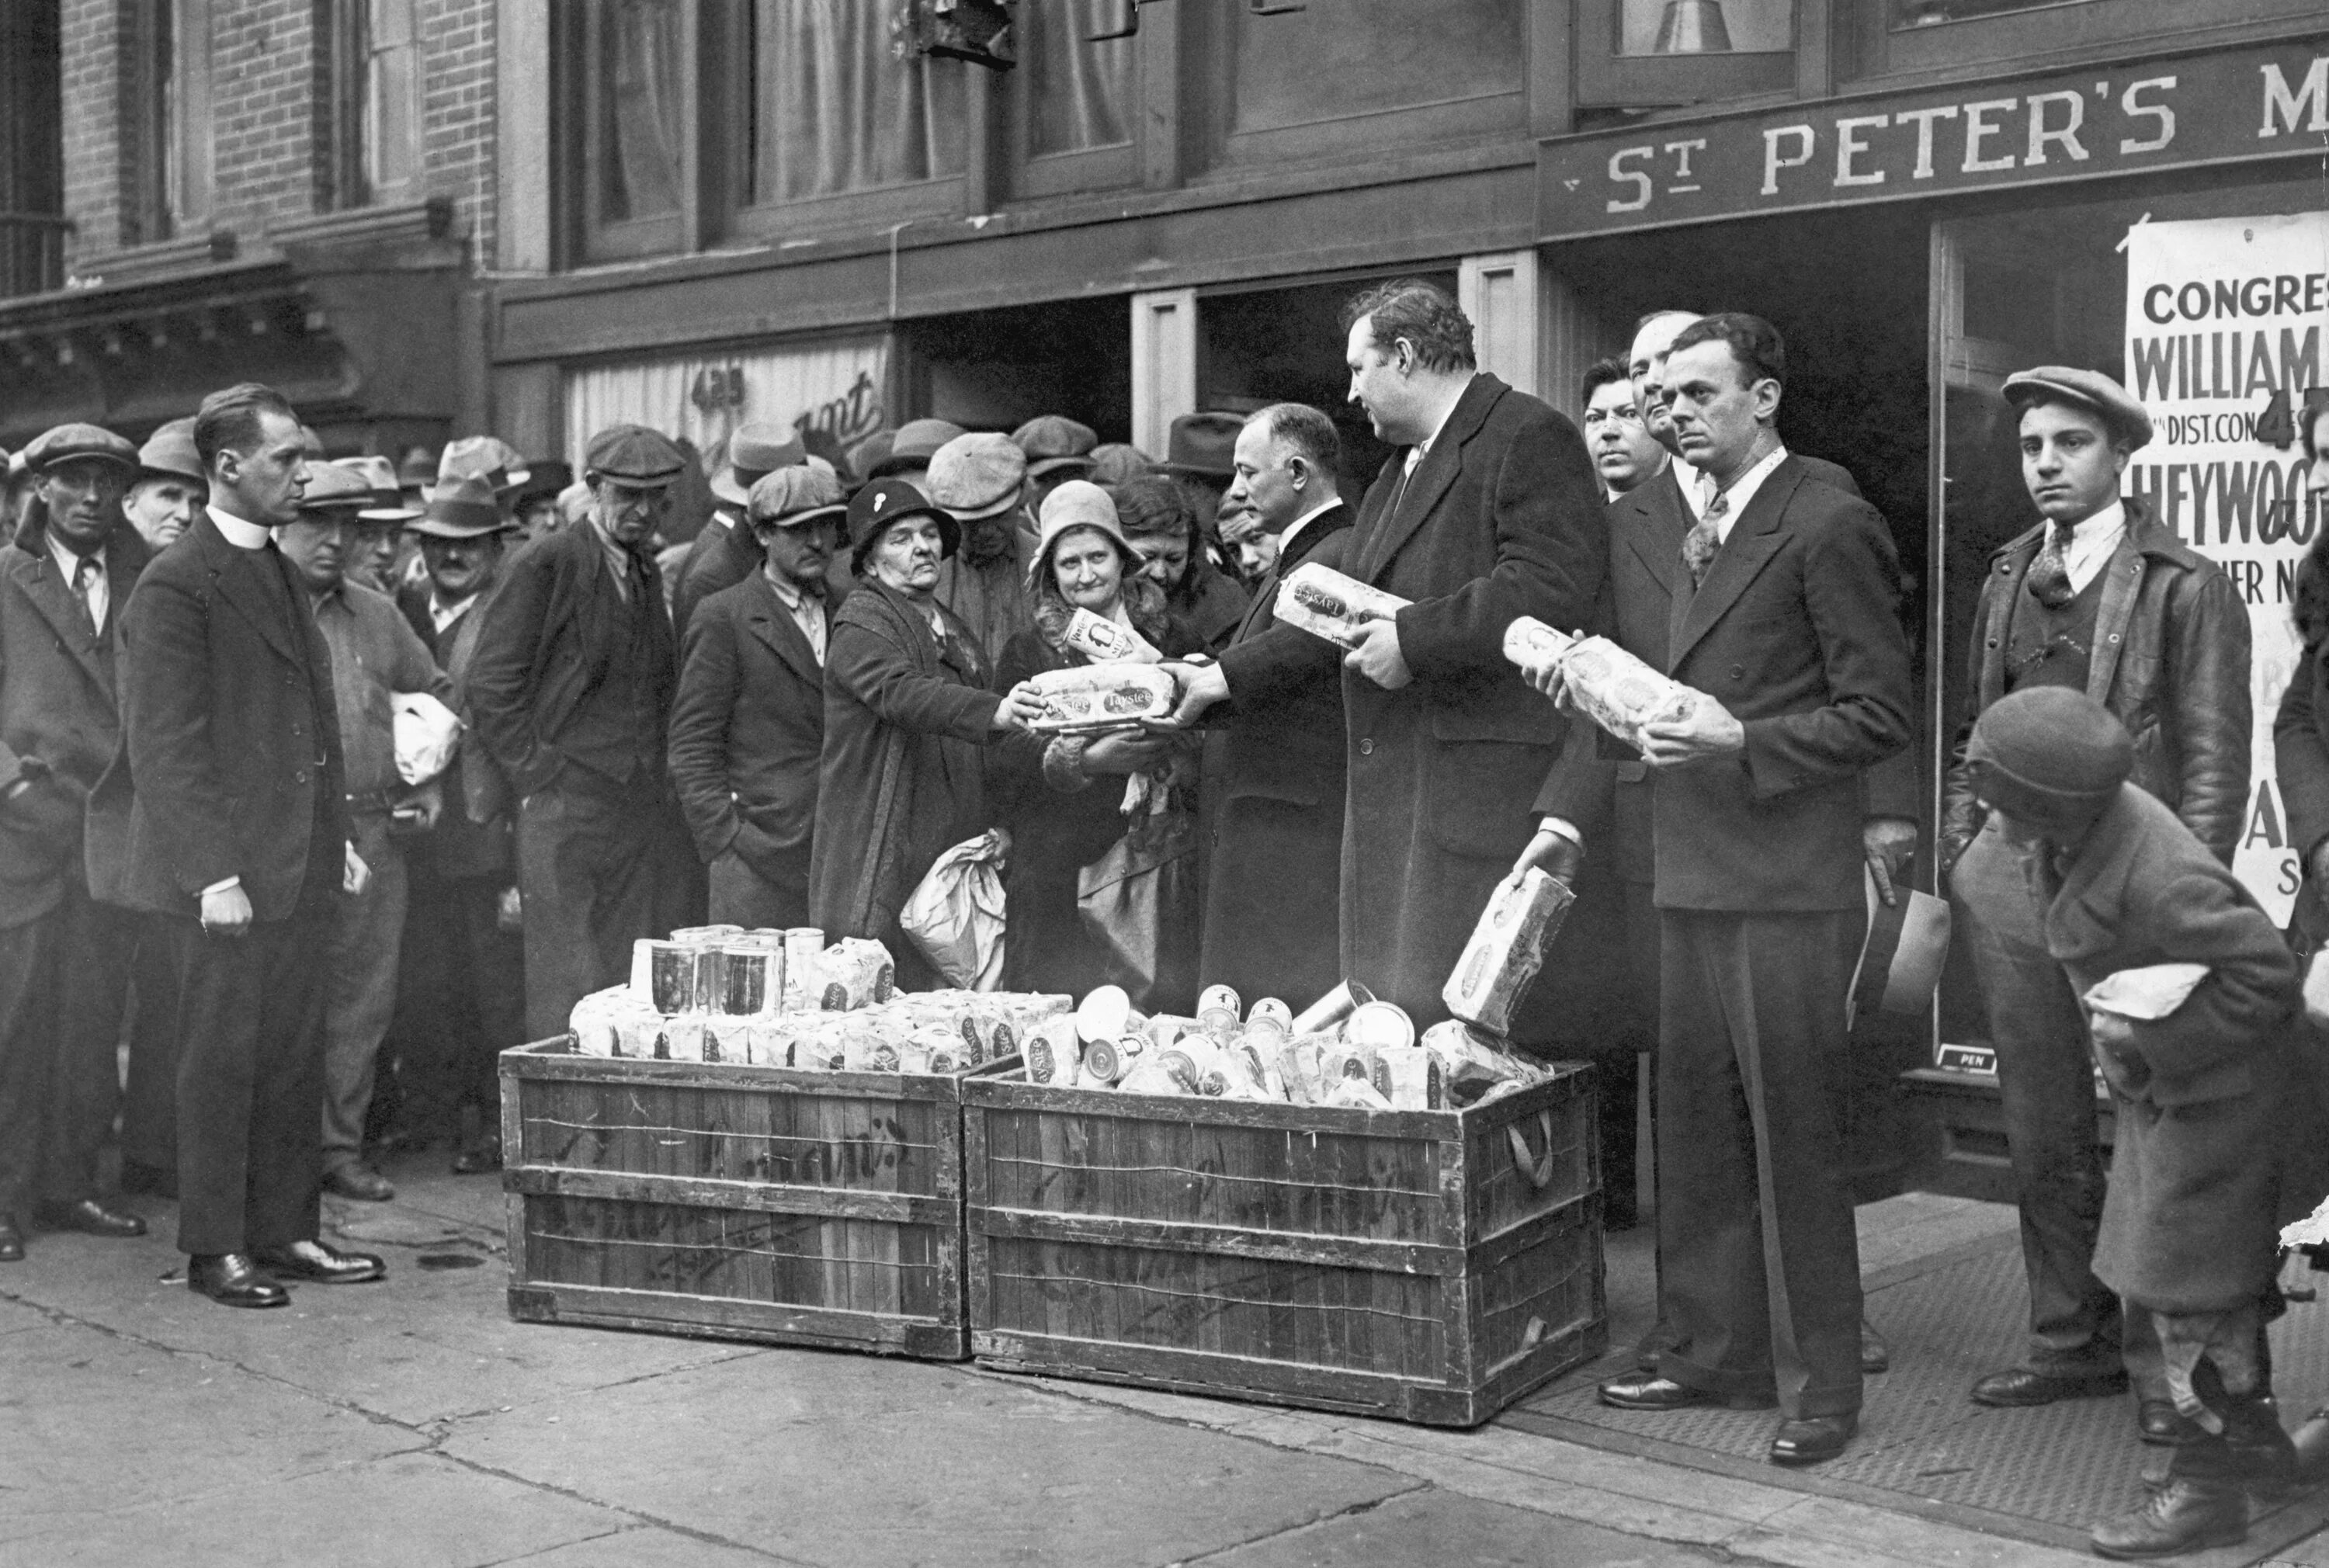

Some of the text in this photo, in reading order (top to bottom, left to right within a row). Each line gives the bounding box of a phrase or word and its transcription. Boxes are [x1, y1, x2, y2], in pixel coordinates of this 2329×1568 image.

[1760, 75, 2177, 196] PETER'S
[2143, 272, 2329, 324] CONGRE
[2133, 325, 2320, 402] WILLIAM
[1295, 585, 1340, 616] Taystee
[1107, 690, 1152, 709] Taystee
